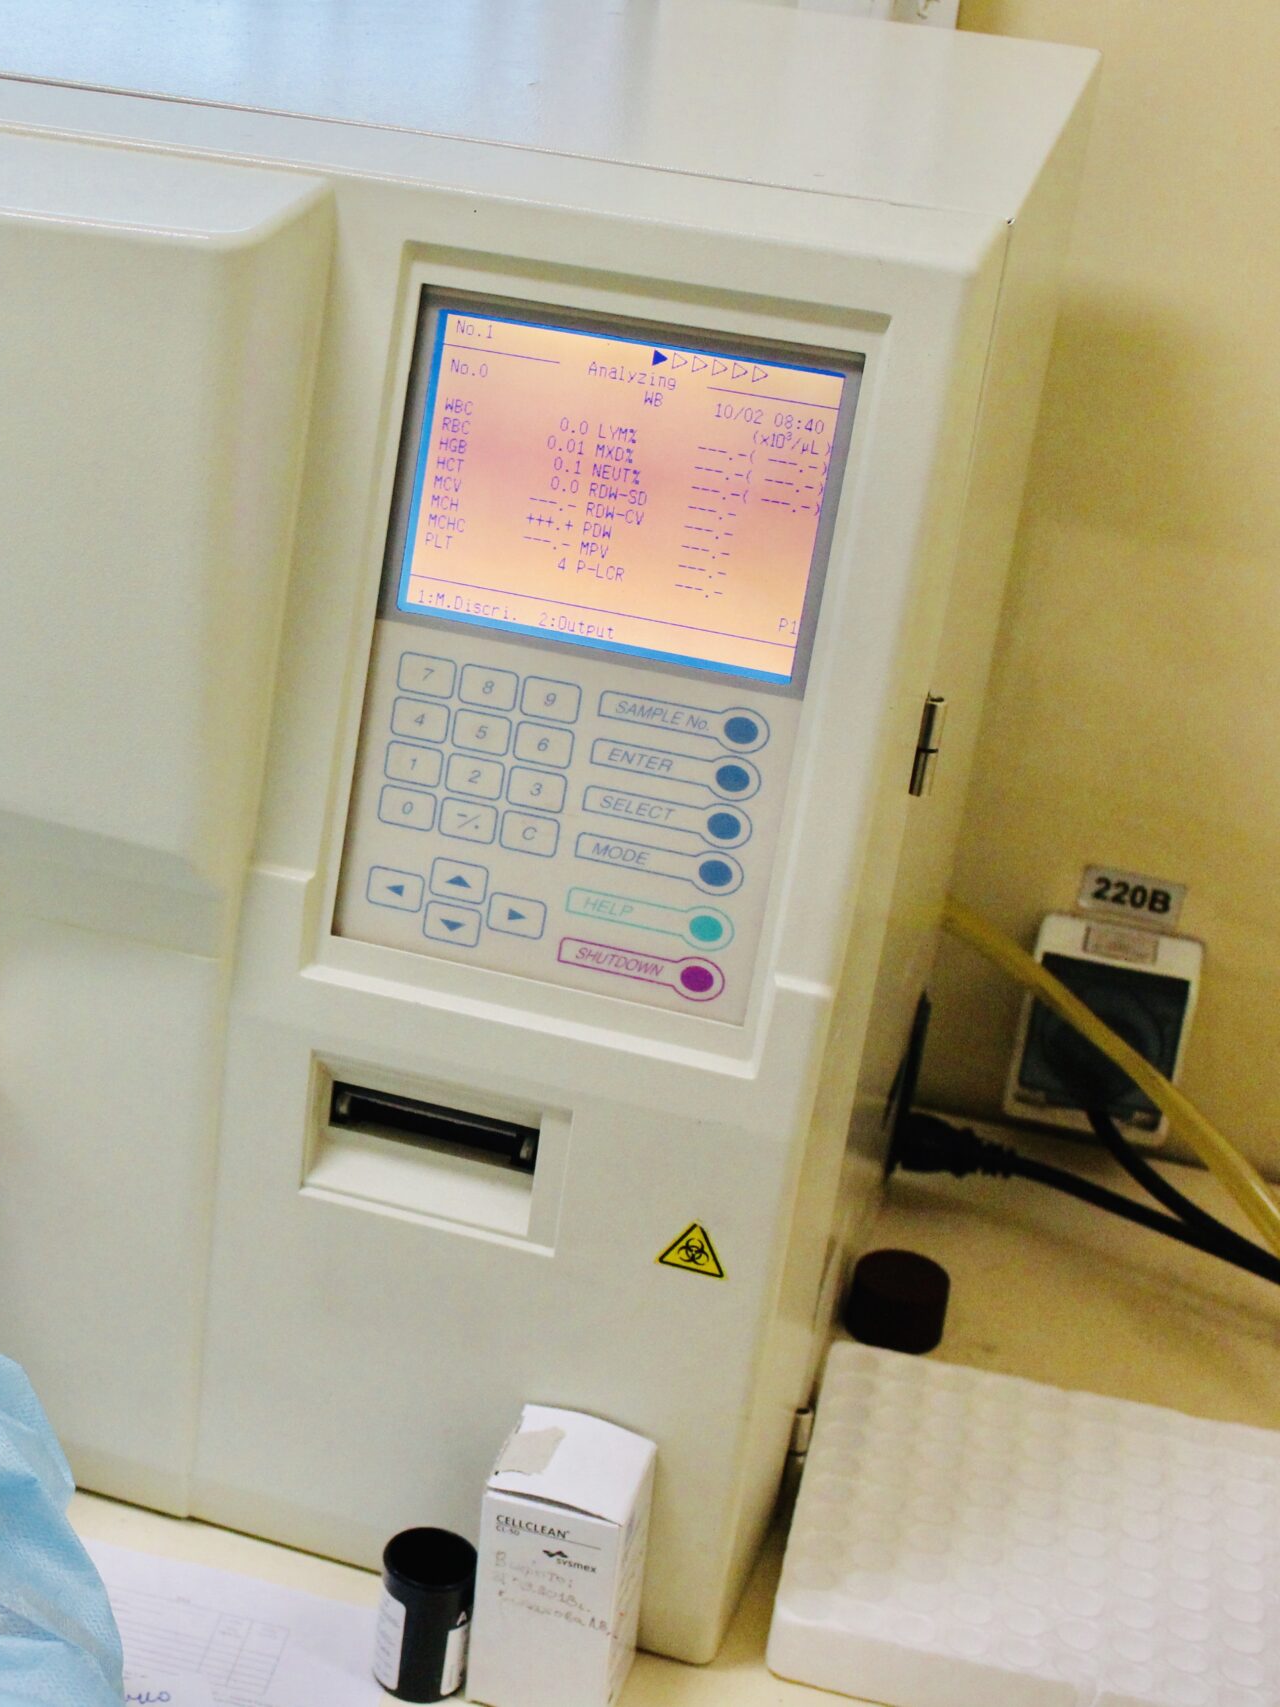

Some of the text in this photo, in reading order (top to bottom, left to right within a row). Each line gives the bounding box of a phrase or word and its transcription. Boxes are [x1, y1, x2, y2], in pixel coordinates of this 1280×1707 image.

[456, 320, 493, 339] No.1
[451, 359, 488, 378] No.0
[588, 361, 677, 390] Analyzing
[644, 390, 663, 407] WB
[445, 398, 473, 416] WBC
[560, 417, 588, 435] 0.0
[598, 423, 637, 444] LYM%
[714, 403, 825, 435] 10/02 08:40
[442, 417, 471, 435] RBC
[547, 435, 584, 455] 0.01
[595, 444, 633, 464] MXD%
[440, 437, 467, 454] HGB
[554, 457, 581, 474] 0.1
[592, 463, 640, 485] NEUT%
[437, 456, 464, 472] HCT
[551, 476, 579, 494] 0.0
[589, 482, 647, 506] RDW-SD
[434, 475, 462, 493] MCV
[586, 502, 645, 526] RDW-CV
[431, 494, 459, 512] MCH
[583, 521, 612, 539] PDW
[428, 513, 466, 533] MCHC
[580, 541, 609, 559] MPV
[425, 532, 453, 549] PLT
[558, 558, 566, 570] 4
[576, 560, 625, 582] P-LCR
[538, 612, 614, 639] 2:Output
[423, 667, 435, 681] 7
[482, 680, 495, 695] 8
[544, 693, 557, 707] 9
[414, 713, 425, 727] 4
[616, 700, 710, 731] SAMPLE No.
[475, 725, 488, 739] 5
[537, 738, 550, 751] 6
[410, 758, 418, 771] 1
[608, 747, 674, 773] ENTER
[468, 770, 481, 784] 2
[530, 782, 543, 797] 3
[402, 801, 414, 815] 0
[600, 795, 676, 822] SELECT
[522, 826, 538, 841] C
[592, 842, 650, 866] MODE
[583, 897, 634, 917] HELP
[575, 946, 664, 977] SHUTDOWN
